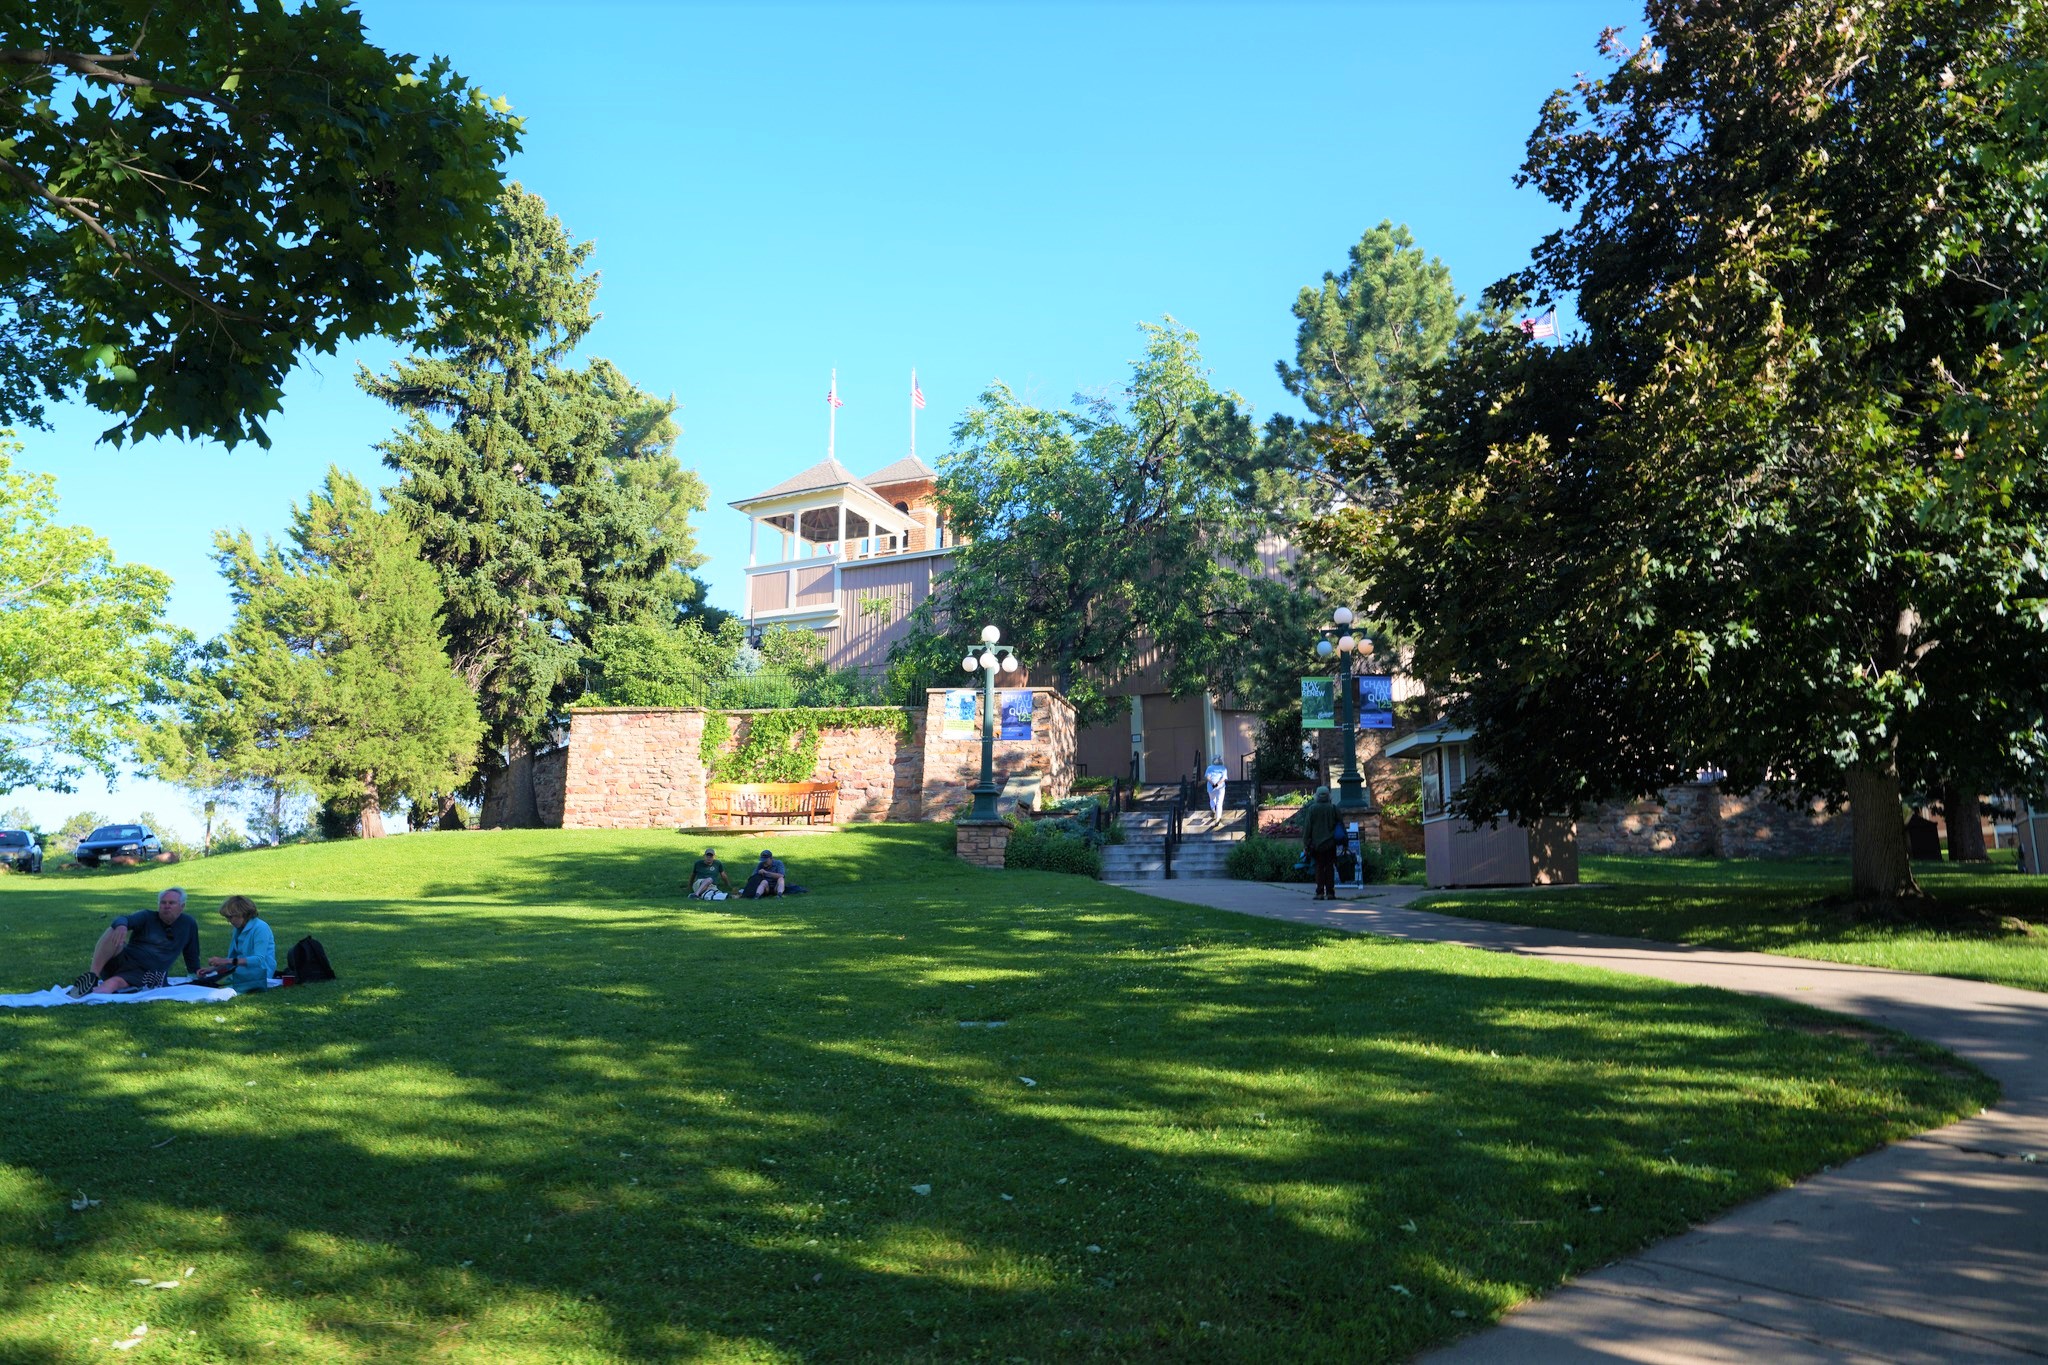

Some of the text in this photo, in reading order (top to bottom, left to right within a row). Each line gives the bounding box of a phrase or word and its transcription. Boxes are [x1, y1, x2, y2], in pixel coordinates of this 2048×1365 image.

[1363, 680, 1389, 688] CHAU
[1005, 694, 1030, 702] CHAU
[1368, 694, 1389, 703] QUA
[1009, 707, 1028, 716] QUA
[1018, 714, 1032, 722] 125
